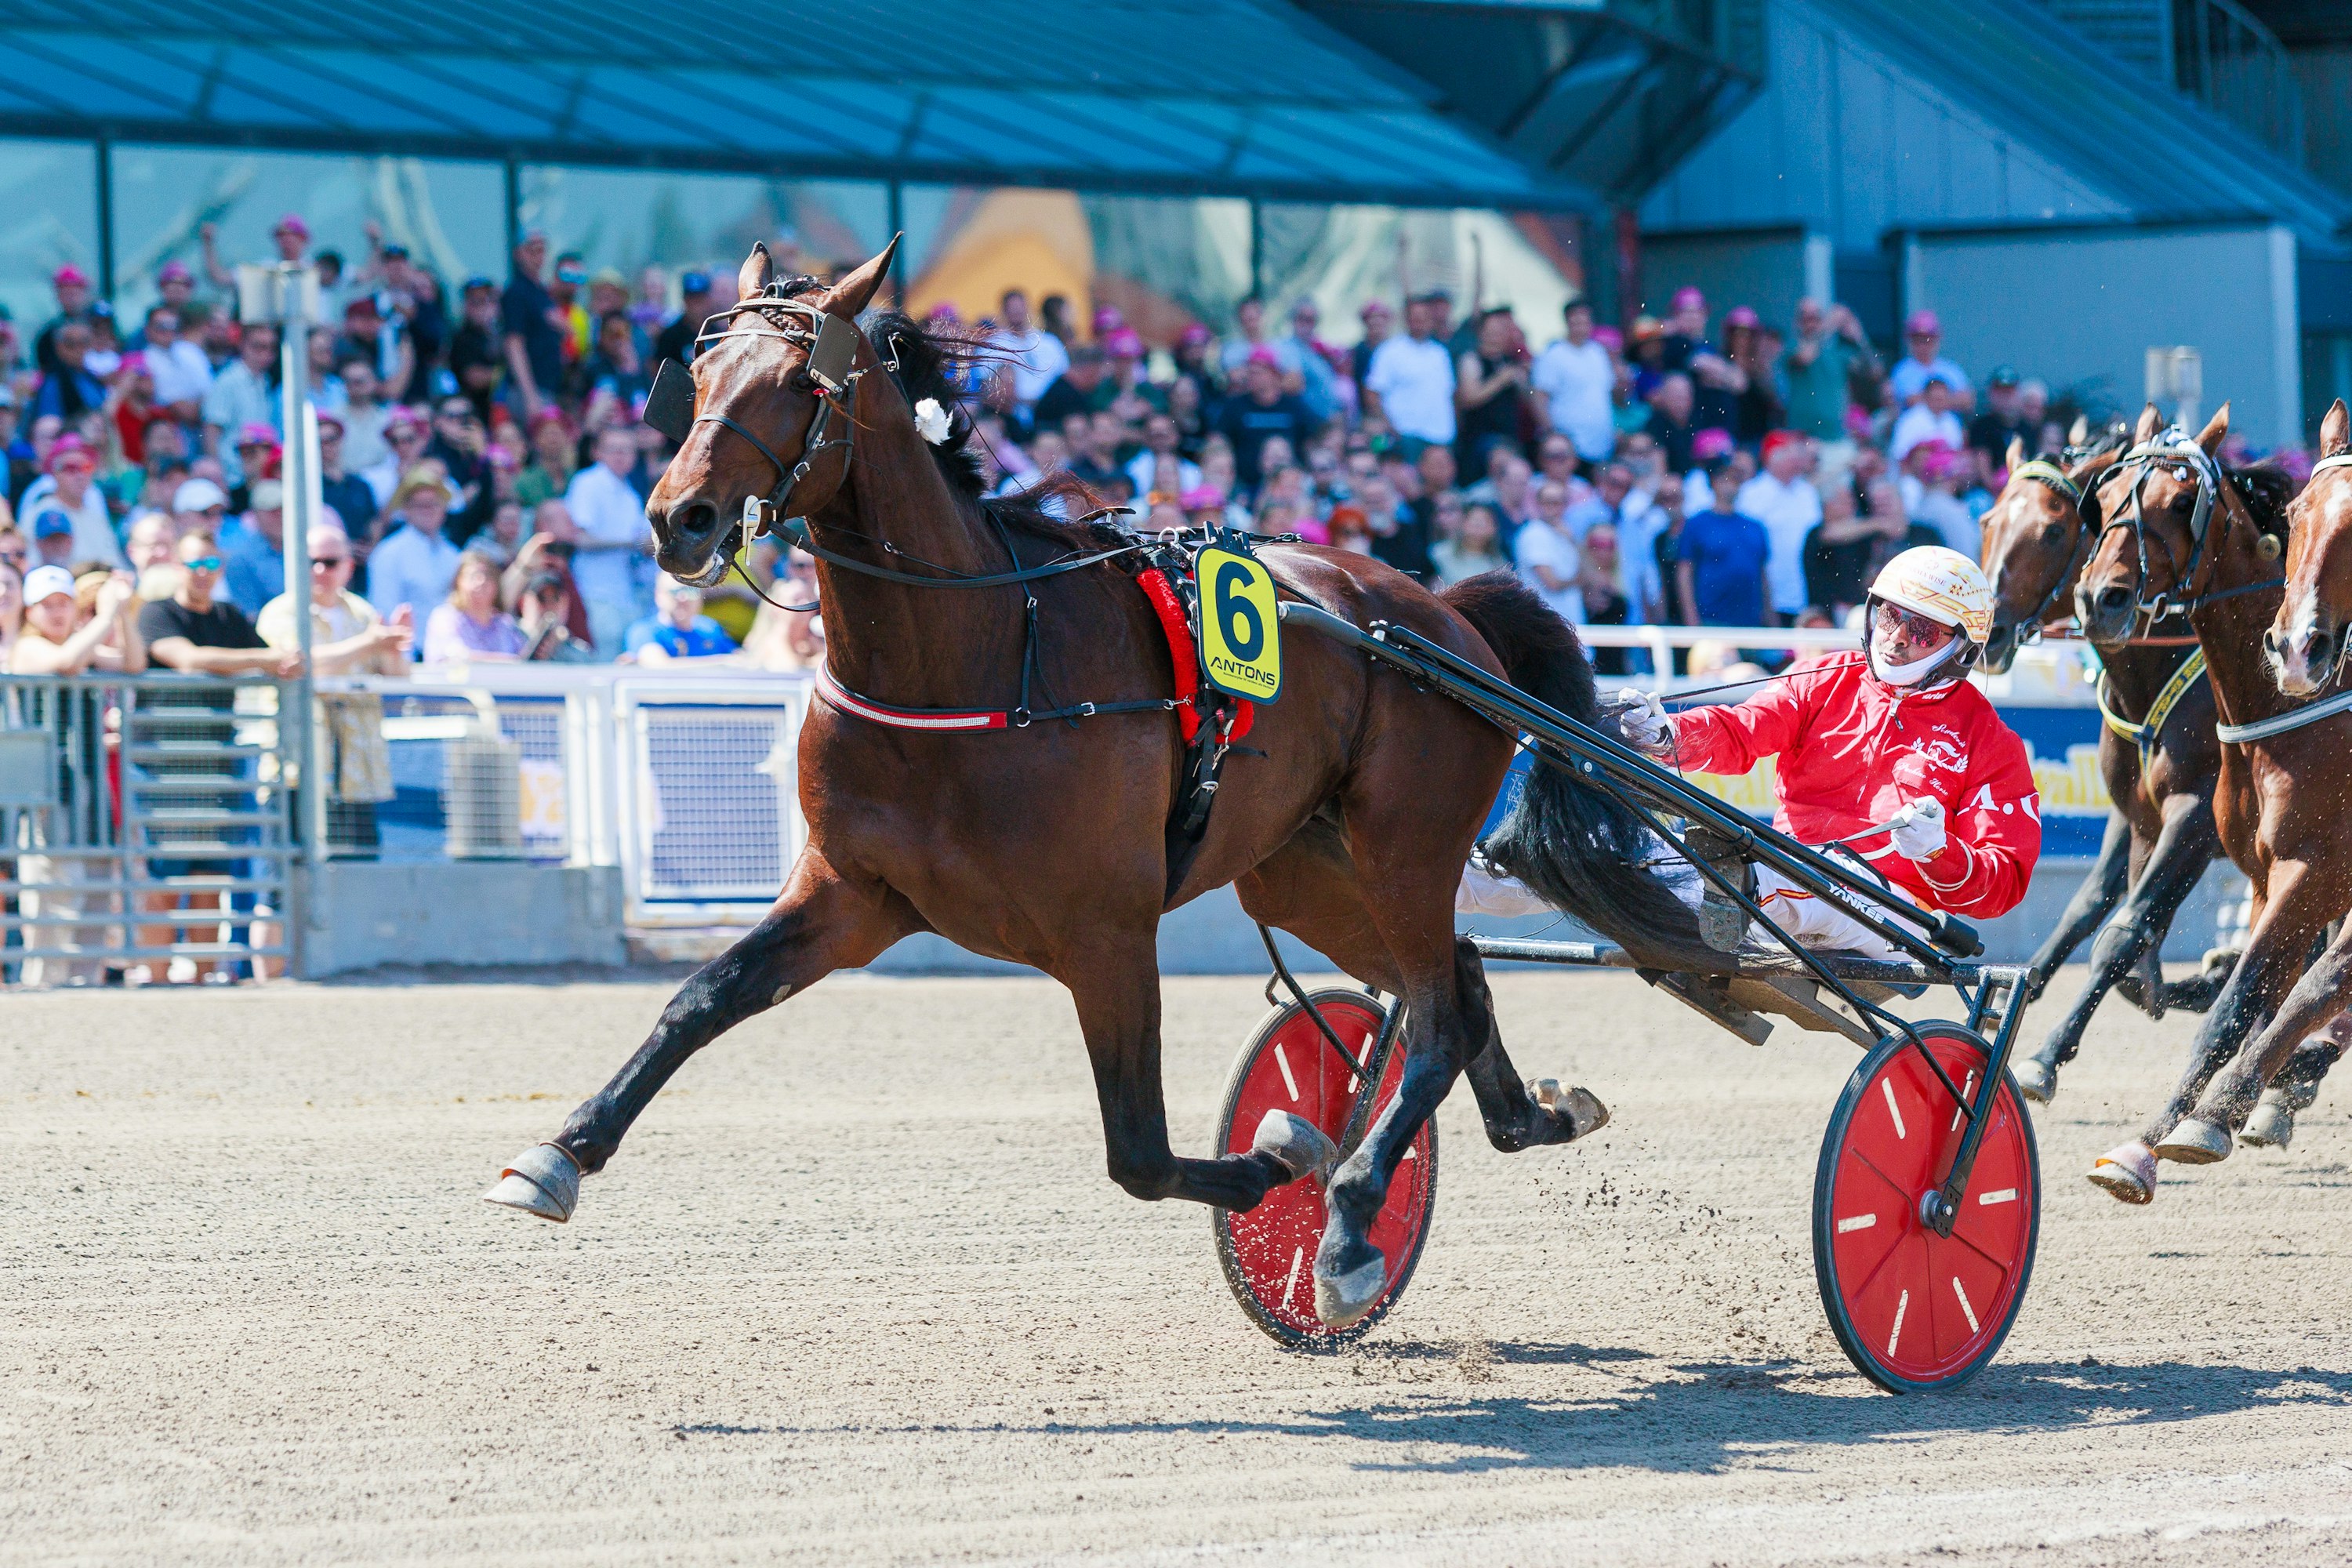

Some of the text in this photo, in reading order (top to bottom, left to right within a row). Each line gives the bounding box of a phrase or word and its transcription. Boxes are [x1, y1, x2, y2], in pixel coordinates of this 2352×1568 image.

[1215, 561, 1264, 662] 6
[1210, 656, 1276, 686] ANTONS
[1929, 777, 1949, 797] Horse
[1828, 881, 1886, 924] YANKEE
